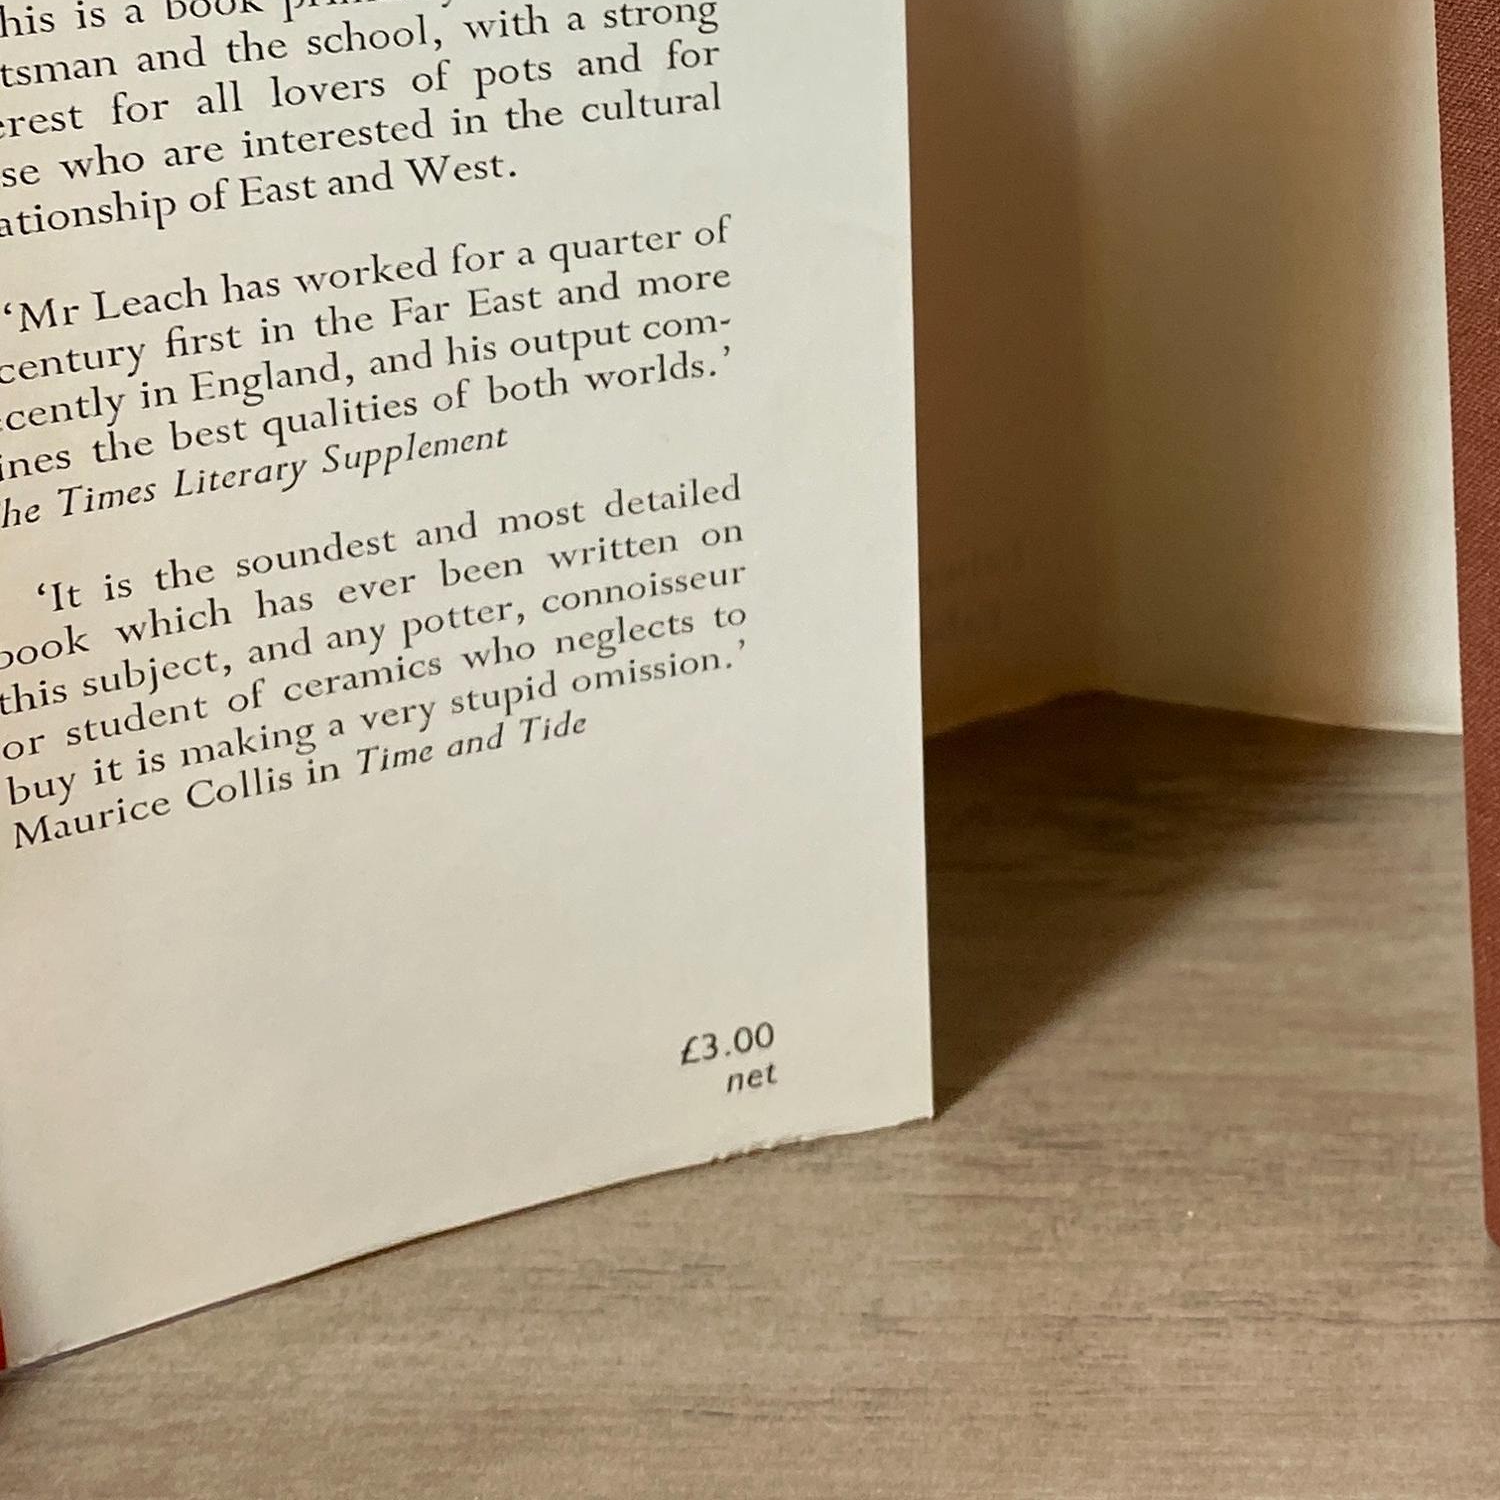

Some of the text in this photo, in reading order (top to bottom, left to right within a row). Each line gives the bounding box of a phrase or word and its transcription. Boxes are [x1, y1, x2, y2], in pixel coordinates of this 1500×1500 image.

[137, 2, 718, 72] and the school, with a strong
[58, 81, 721, 179] who are interested in the cultural
[190, 155, 516, 212] of East and West.
[4, 213, 731, 332] 'Mr Leach has worked for a quarter of
[166, 325, 242, 358] first
[261, 318, 294, 345] in
[315, 305, 373, 337] the
[390, 297, 450, 327] Far
[467, 287, 542, 317] East
[558, 270, 620, 306] and
[637, 270, 731, 298] more
[92, 345, 730, 463] the best qualities of both worlds.'
[57, 428, 508, 516] Times Literary Supplement
[38, 473, 740, 611] 'It is the soundest and most detailed
[3, 607, 746, 760] or student of ceramics who neglects to
[83, 650, 231, 697] subject,
[249, 626, 312, 664] and
[327, 624, 385, 656] any
[402, 602, 524, 649] potter,
[542, 566, 746, 613] connoisseur
[6, 639, 744, 806] buy it is making a very stupid omission.'
[14, 709, 586, 849] Maurice Collis in Time and Tide
[681, 1021, 774, 1065] £3.00
[727, 1061, 778, 1093] net
